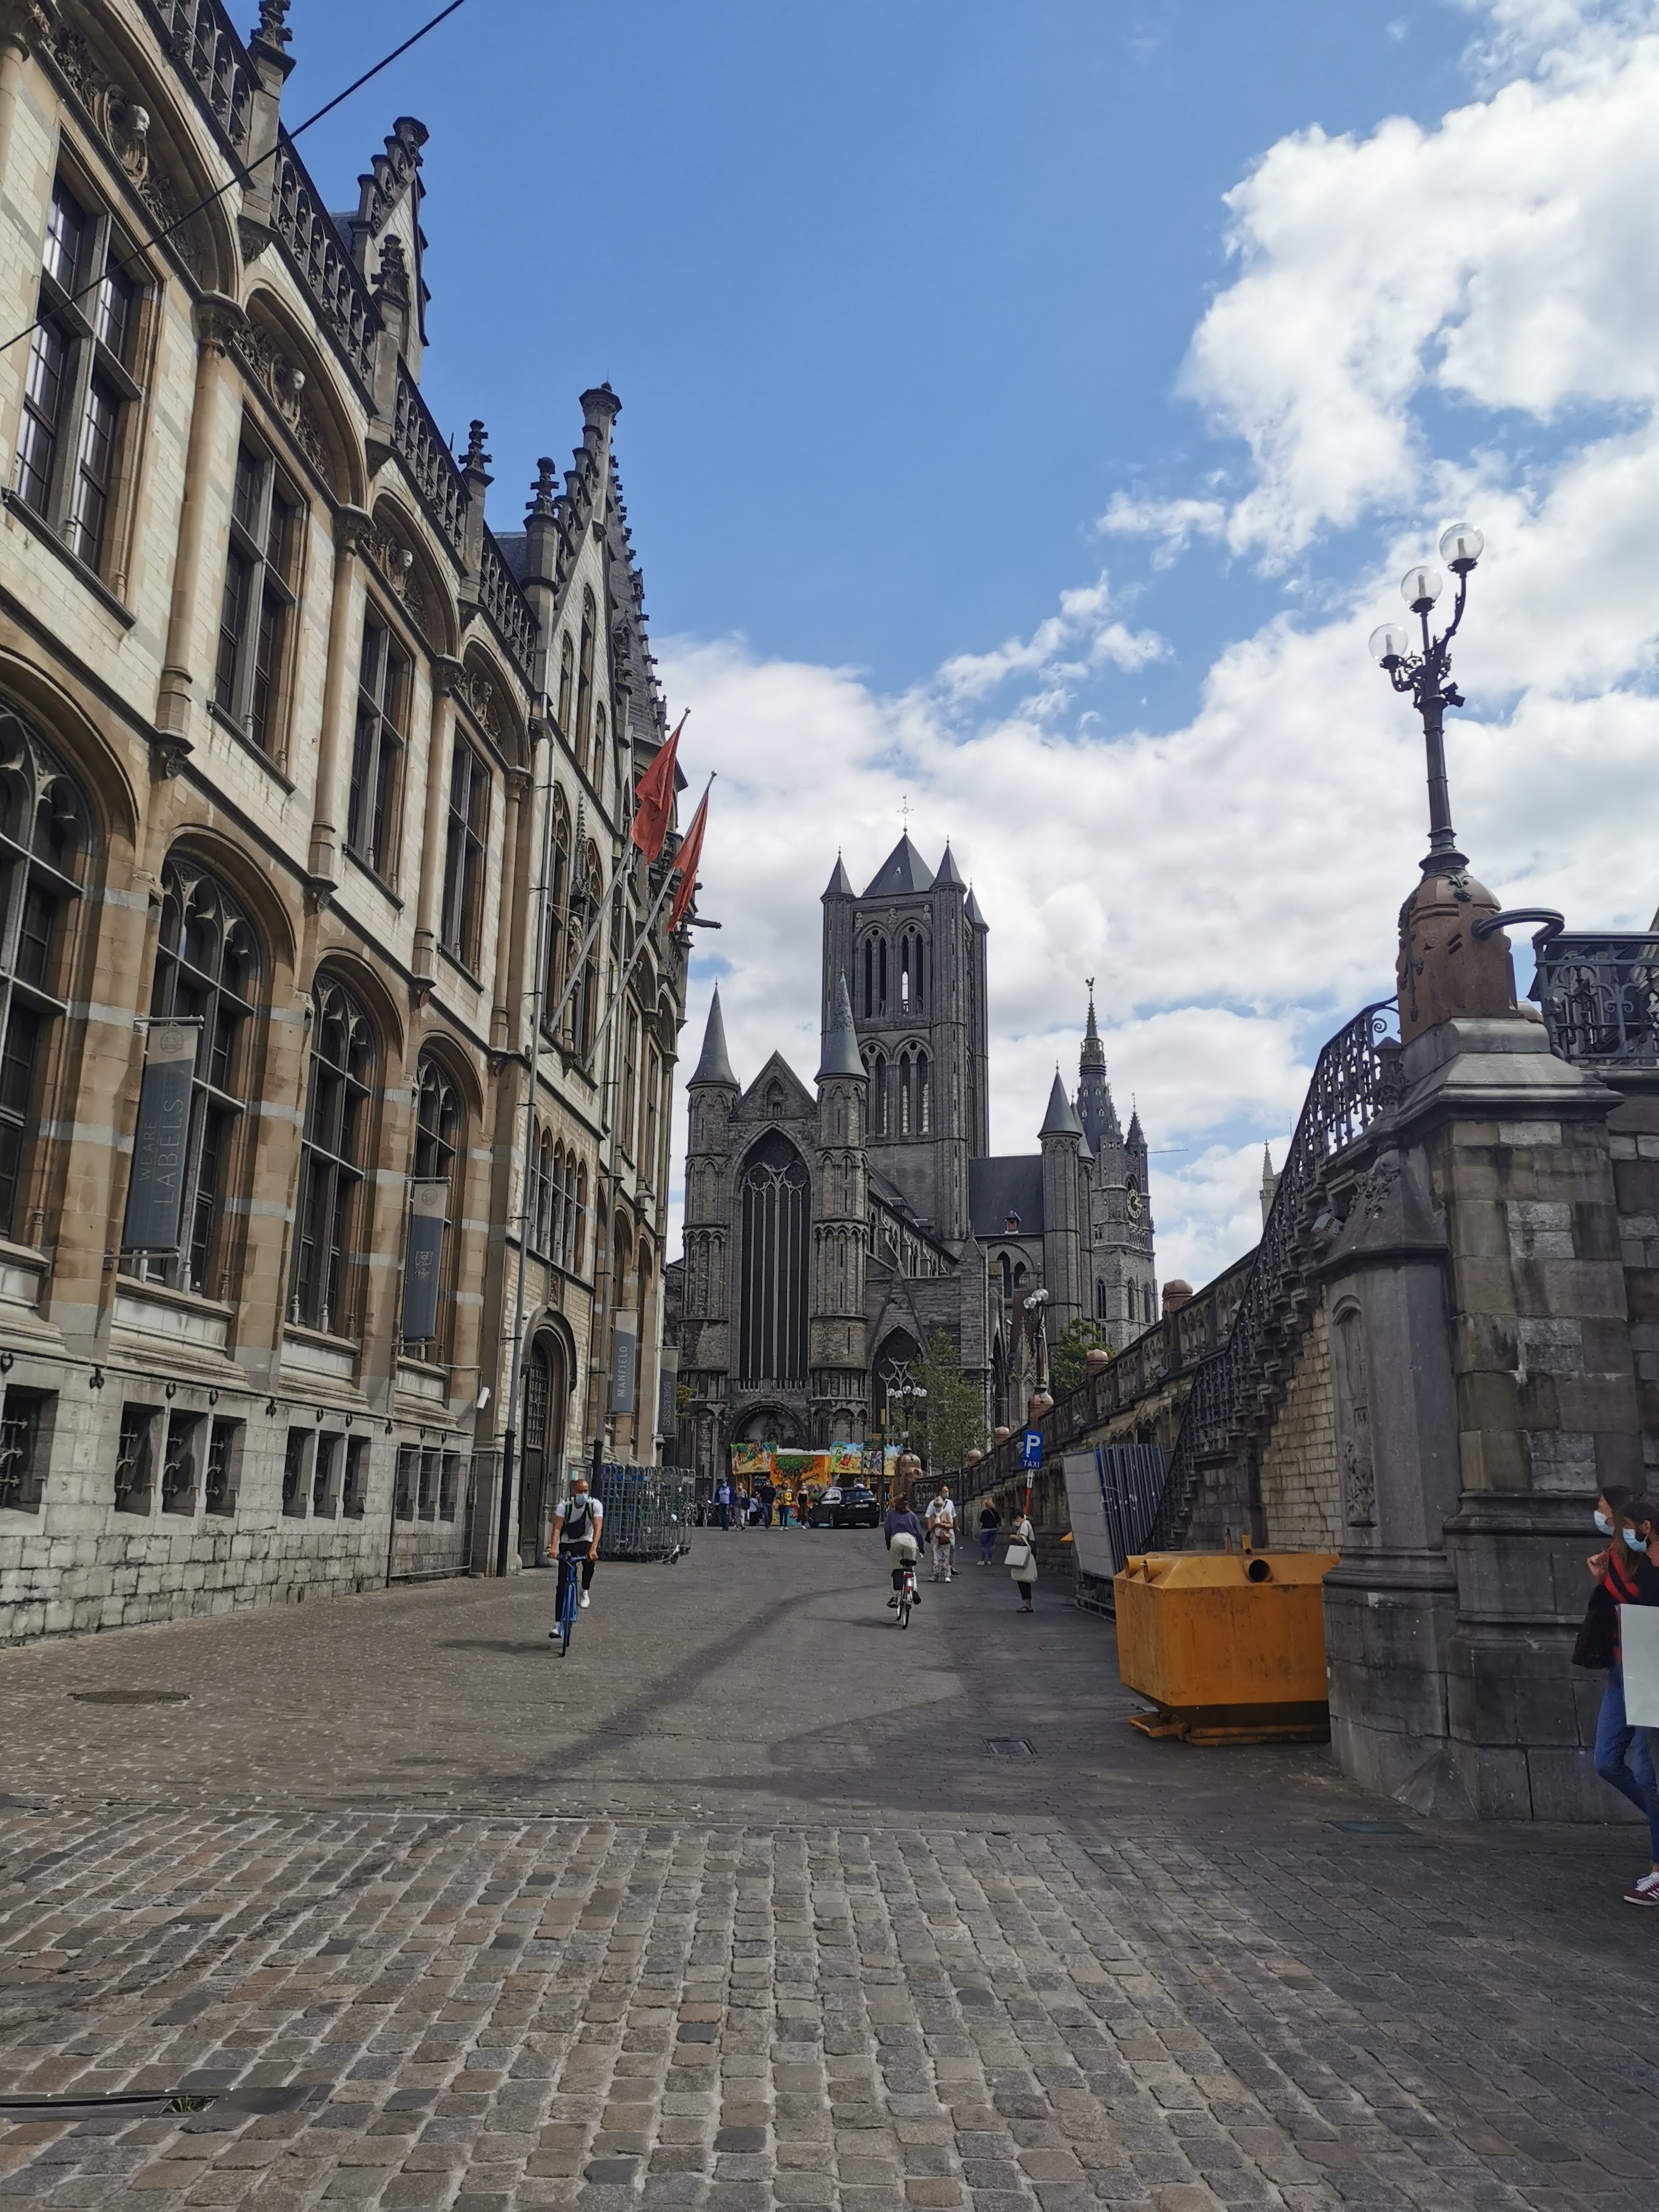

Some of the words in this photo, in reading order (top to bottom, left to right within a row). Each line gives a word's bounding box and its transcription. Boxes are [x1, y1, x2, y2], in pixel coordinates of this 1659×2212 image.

[142, 1121, 157, 1153] ARE
[153, 1099, 184, 1204] LABELS
[138, 1158, 153, 1181] WE
[617, 1346, 628, 1398] MANFIELD
[1026, 1435, 1041, 1458] P
[1023, 1460, 1040, 1468] TAXI
